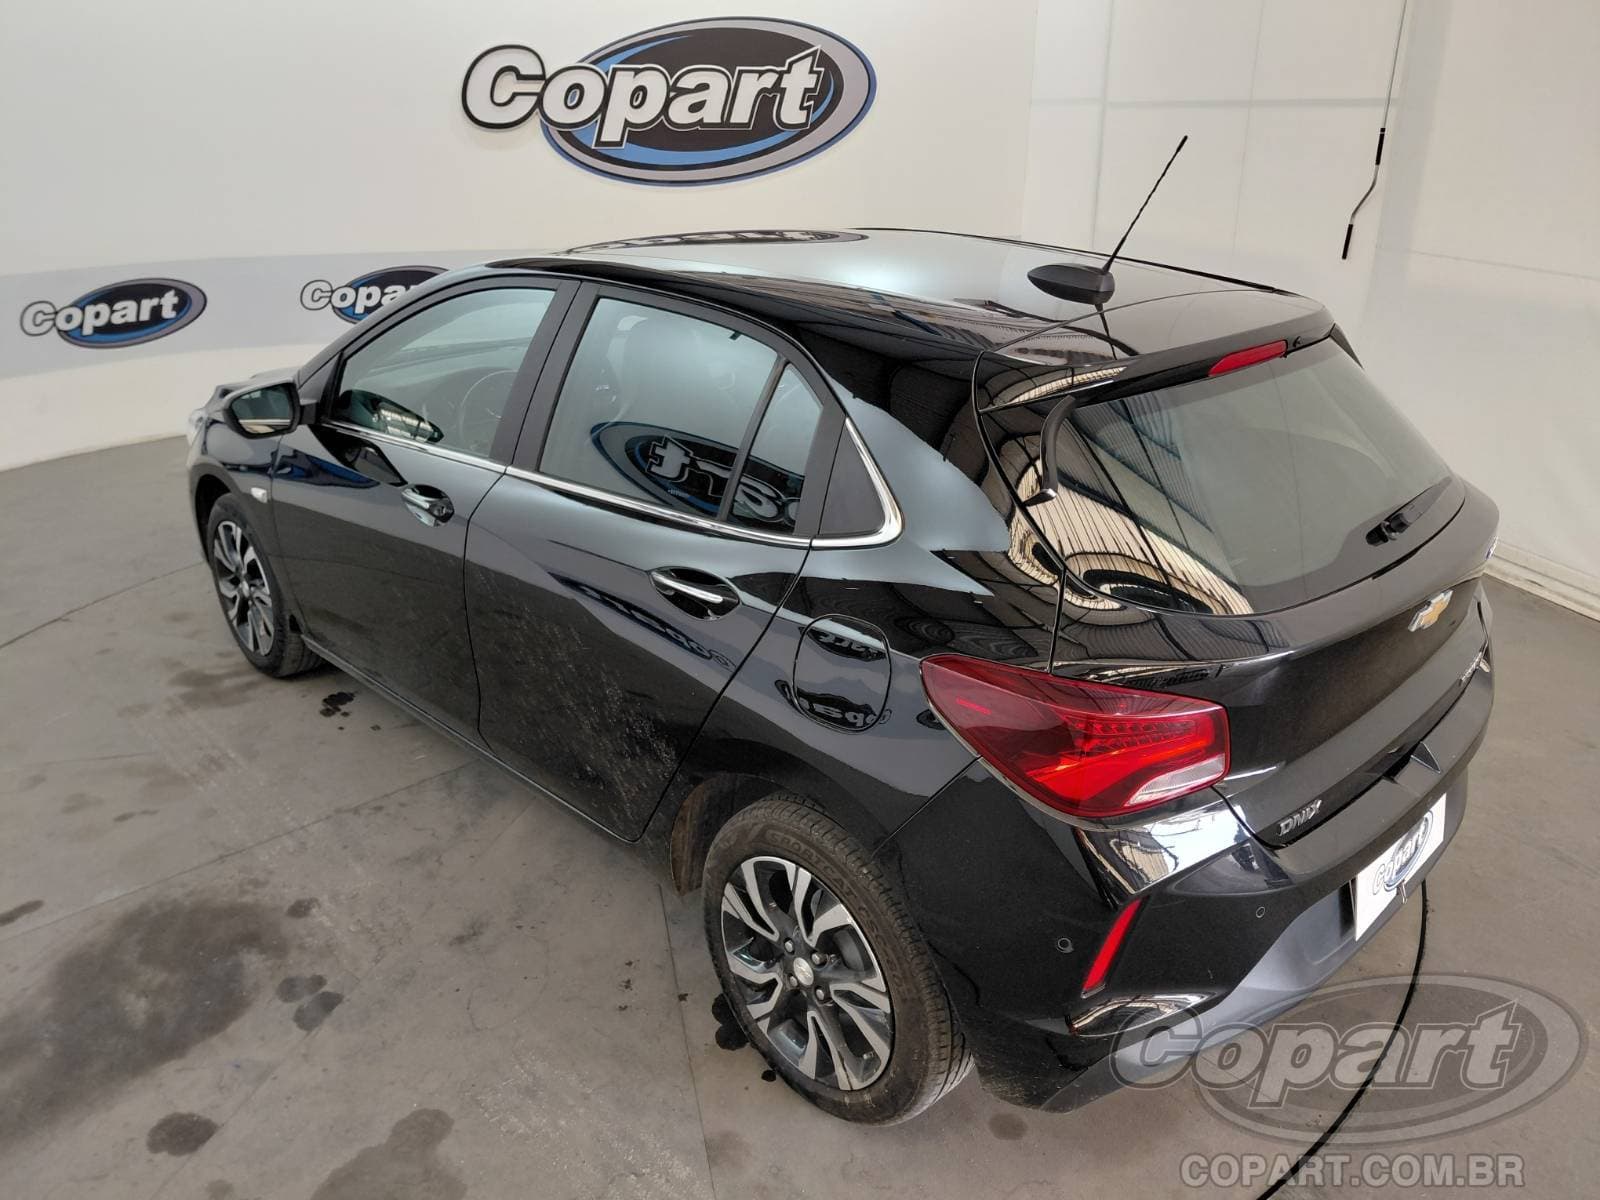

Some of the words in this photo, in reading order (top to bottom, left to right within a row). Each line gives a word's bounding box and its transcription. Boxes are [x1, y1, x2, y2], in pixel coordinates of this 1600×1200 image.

[461, 44, 823, 148] Copart
[20, 289, 180, 336] Copart
[300, 279, 420, 314] Copa
[1373, 820, 1427, 895] Copart
